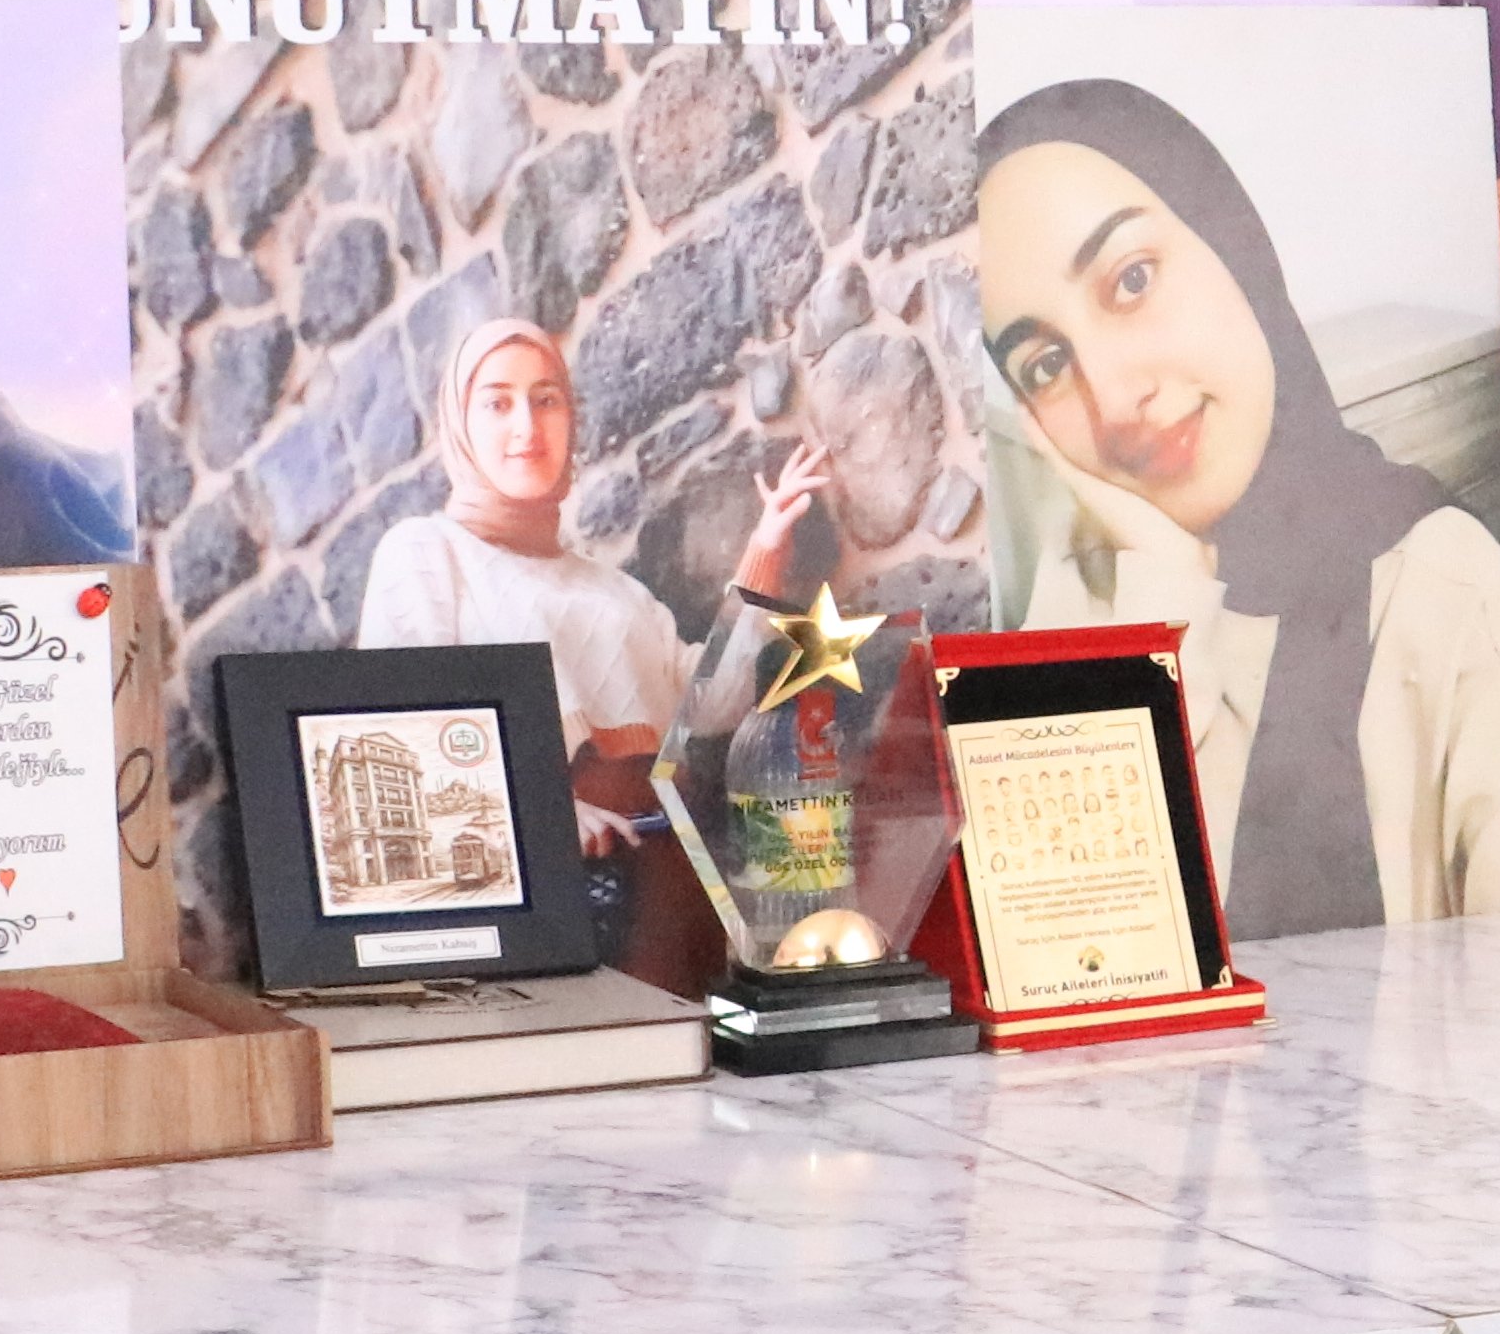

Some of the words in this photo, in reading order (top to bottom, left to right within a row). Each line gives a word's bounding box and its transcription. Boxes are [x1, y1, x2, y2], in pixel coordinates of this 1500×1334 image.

[969, 753, 1003, 765] Adalet
[1021, 984, 1057, 997] Suruç
[1061, 976, 1108, 993] Aileleri
[1111, 968, 1169, 987] İnisiyatifi
